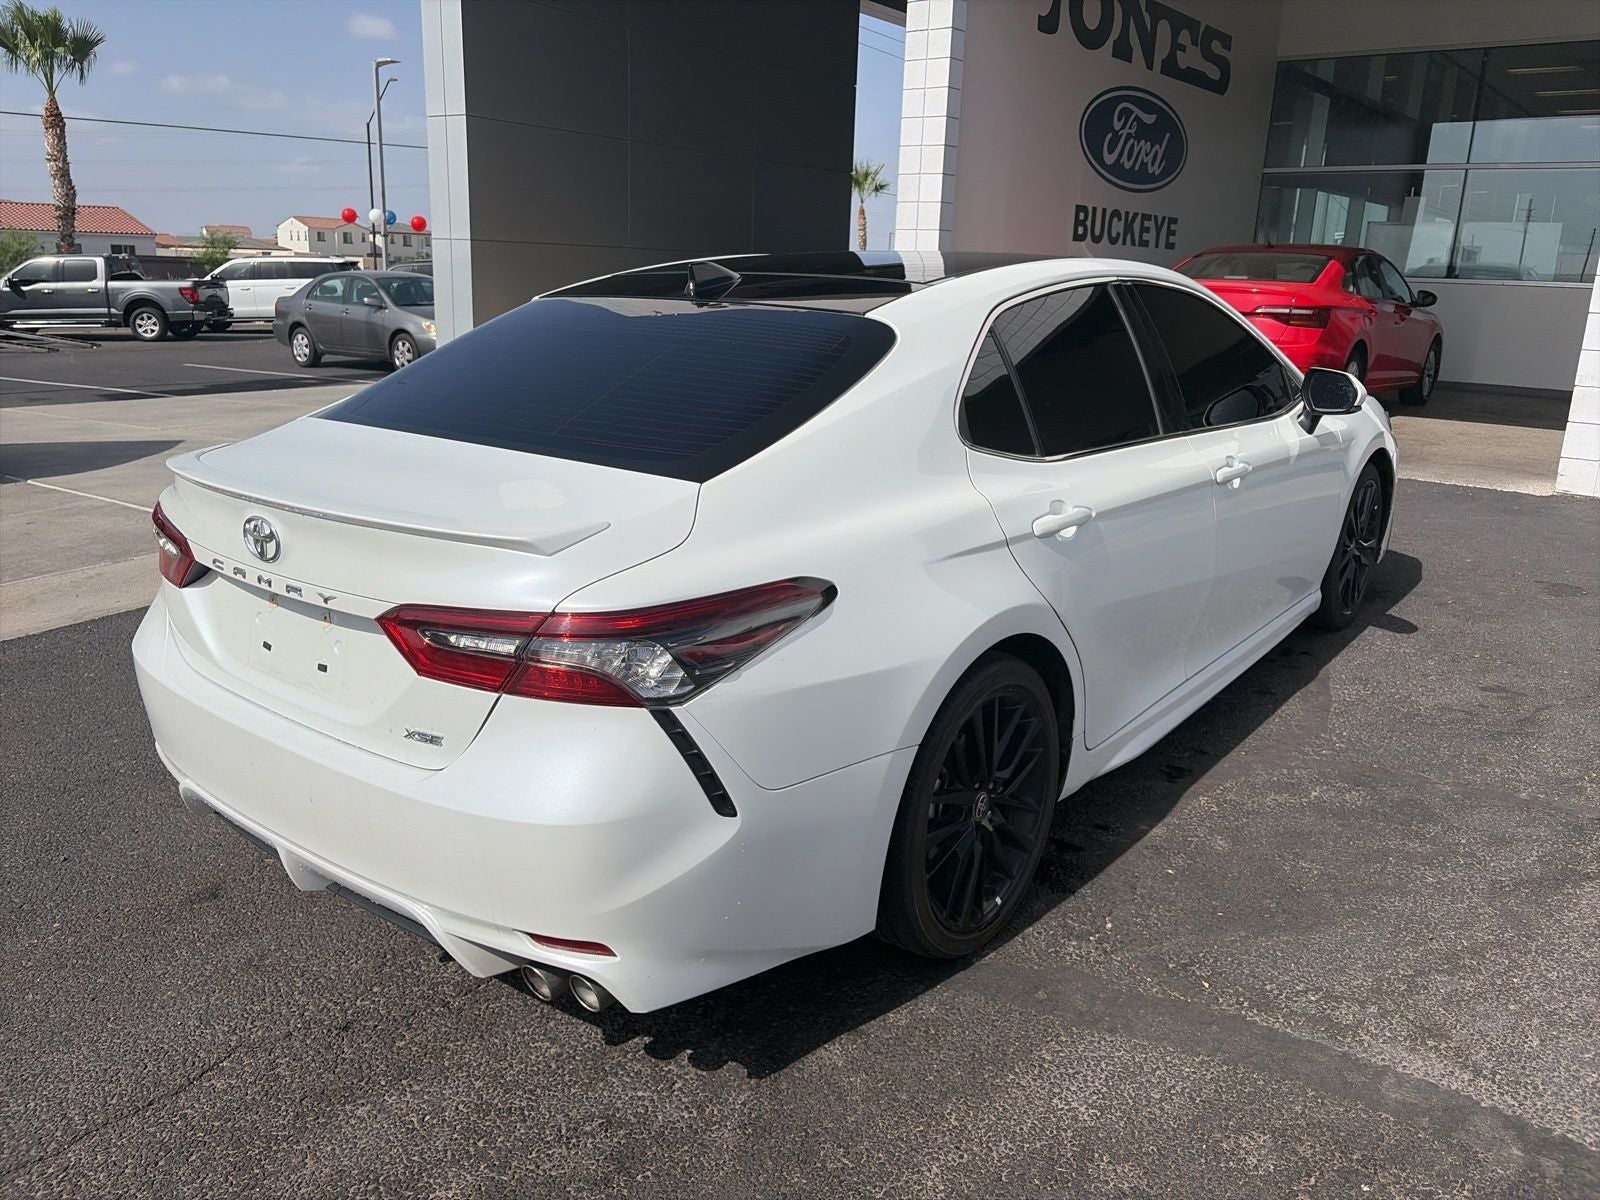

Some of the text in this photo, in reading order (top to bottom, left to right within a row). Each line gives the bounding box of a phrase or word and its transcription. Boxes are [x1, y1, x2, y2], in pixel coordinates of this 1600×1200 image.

[1103, 102, 1170, 176] Ford
[1072, 204, 1178, 250] BUCKEYE
[212, 557, 337, 605] CAMRY
[403, 727, 444, 747] XSE
